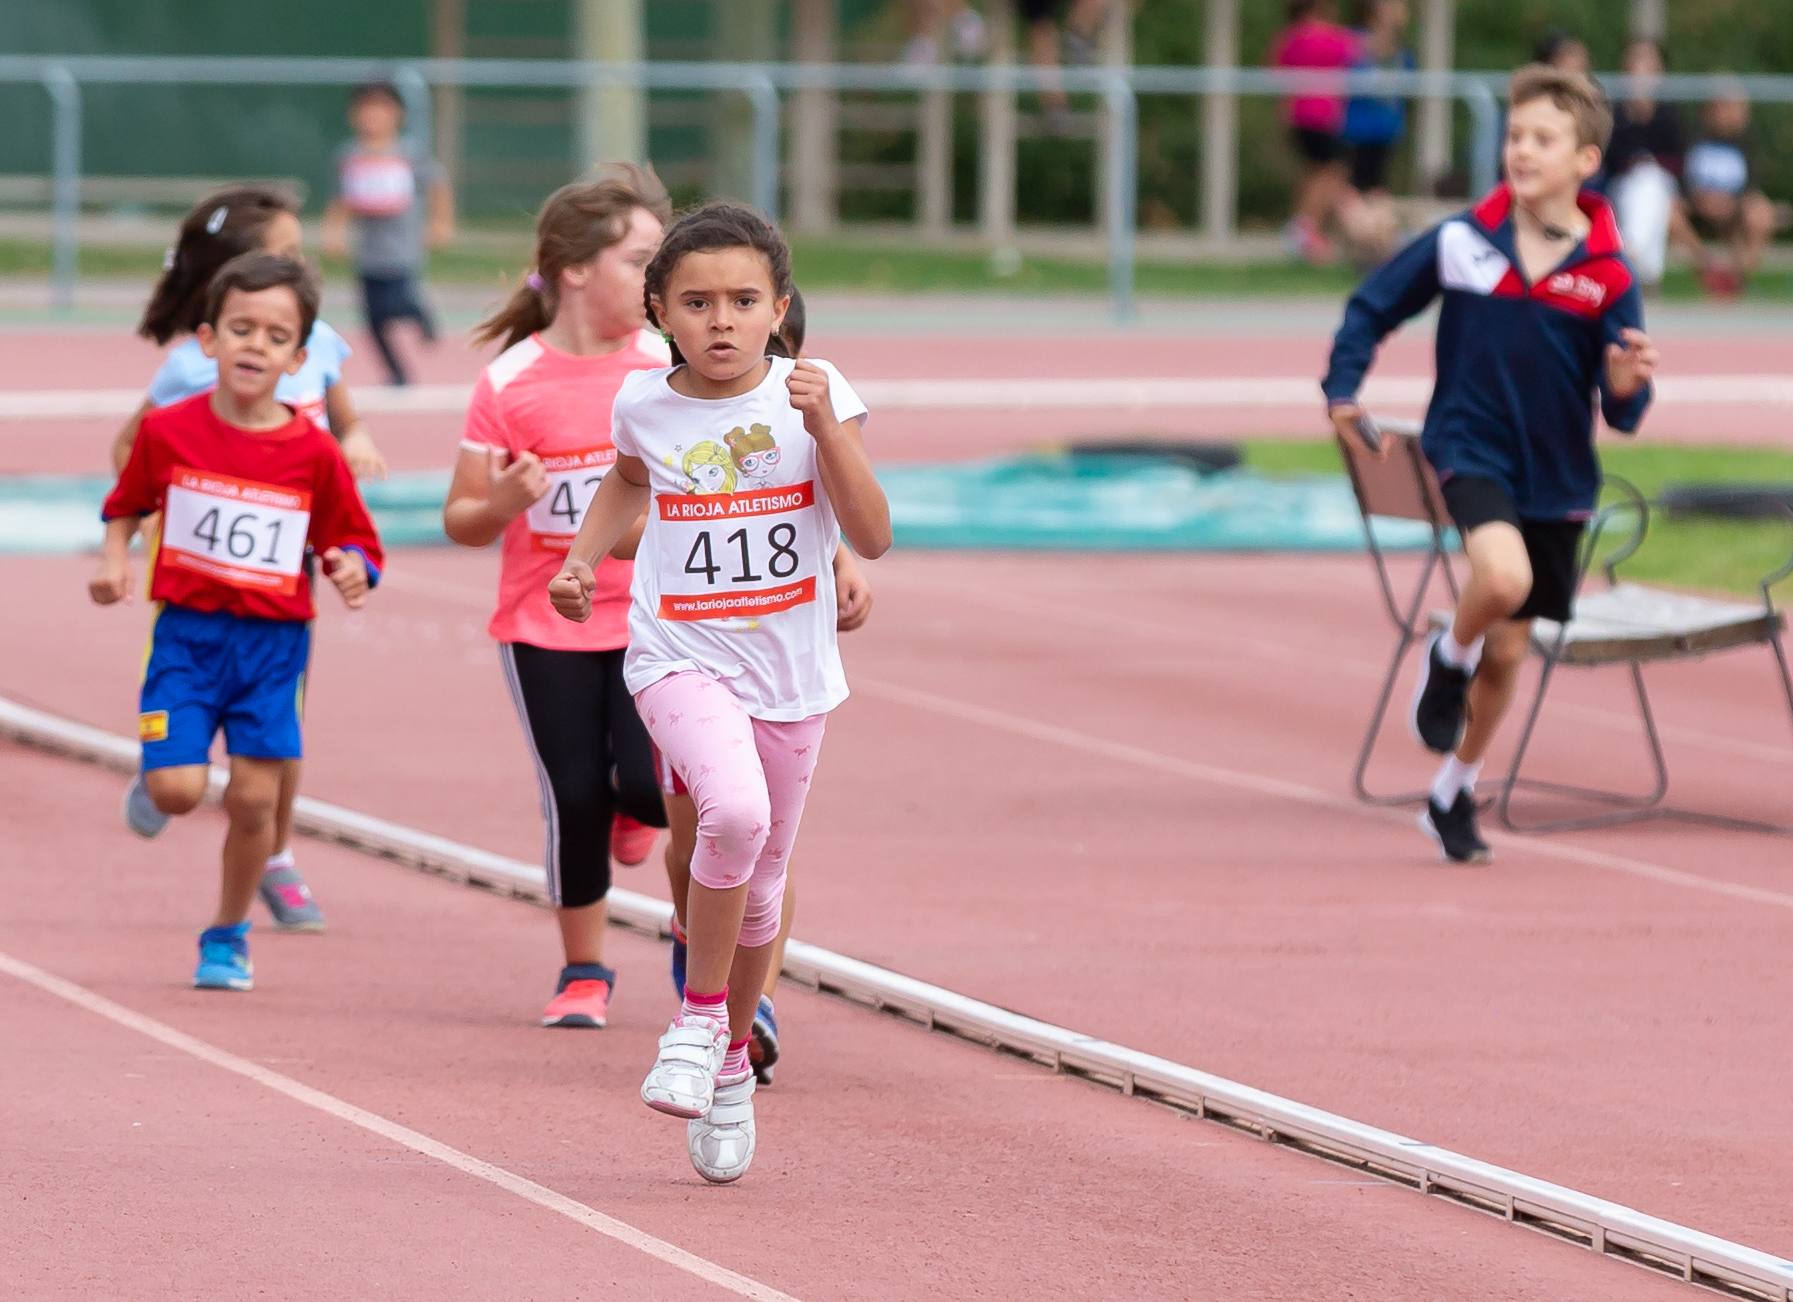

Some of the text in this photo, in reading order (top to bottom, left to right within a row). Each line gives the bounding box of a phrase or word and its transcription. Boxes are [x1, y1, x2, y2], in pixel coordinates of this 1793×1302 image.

[667, 492, 803, 517] LA RIOJA ATLETISMO
[193, 507, 283, 564] 461
[684, 522, 799, 585] 418
[673, 587, 803, 612] www.lariojaatletismo.com
